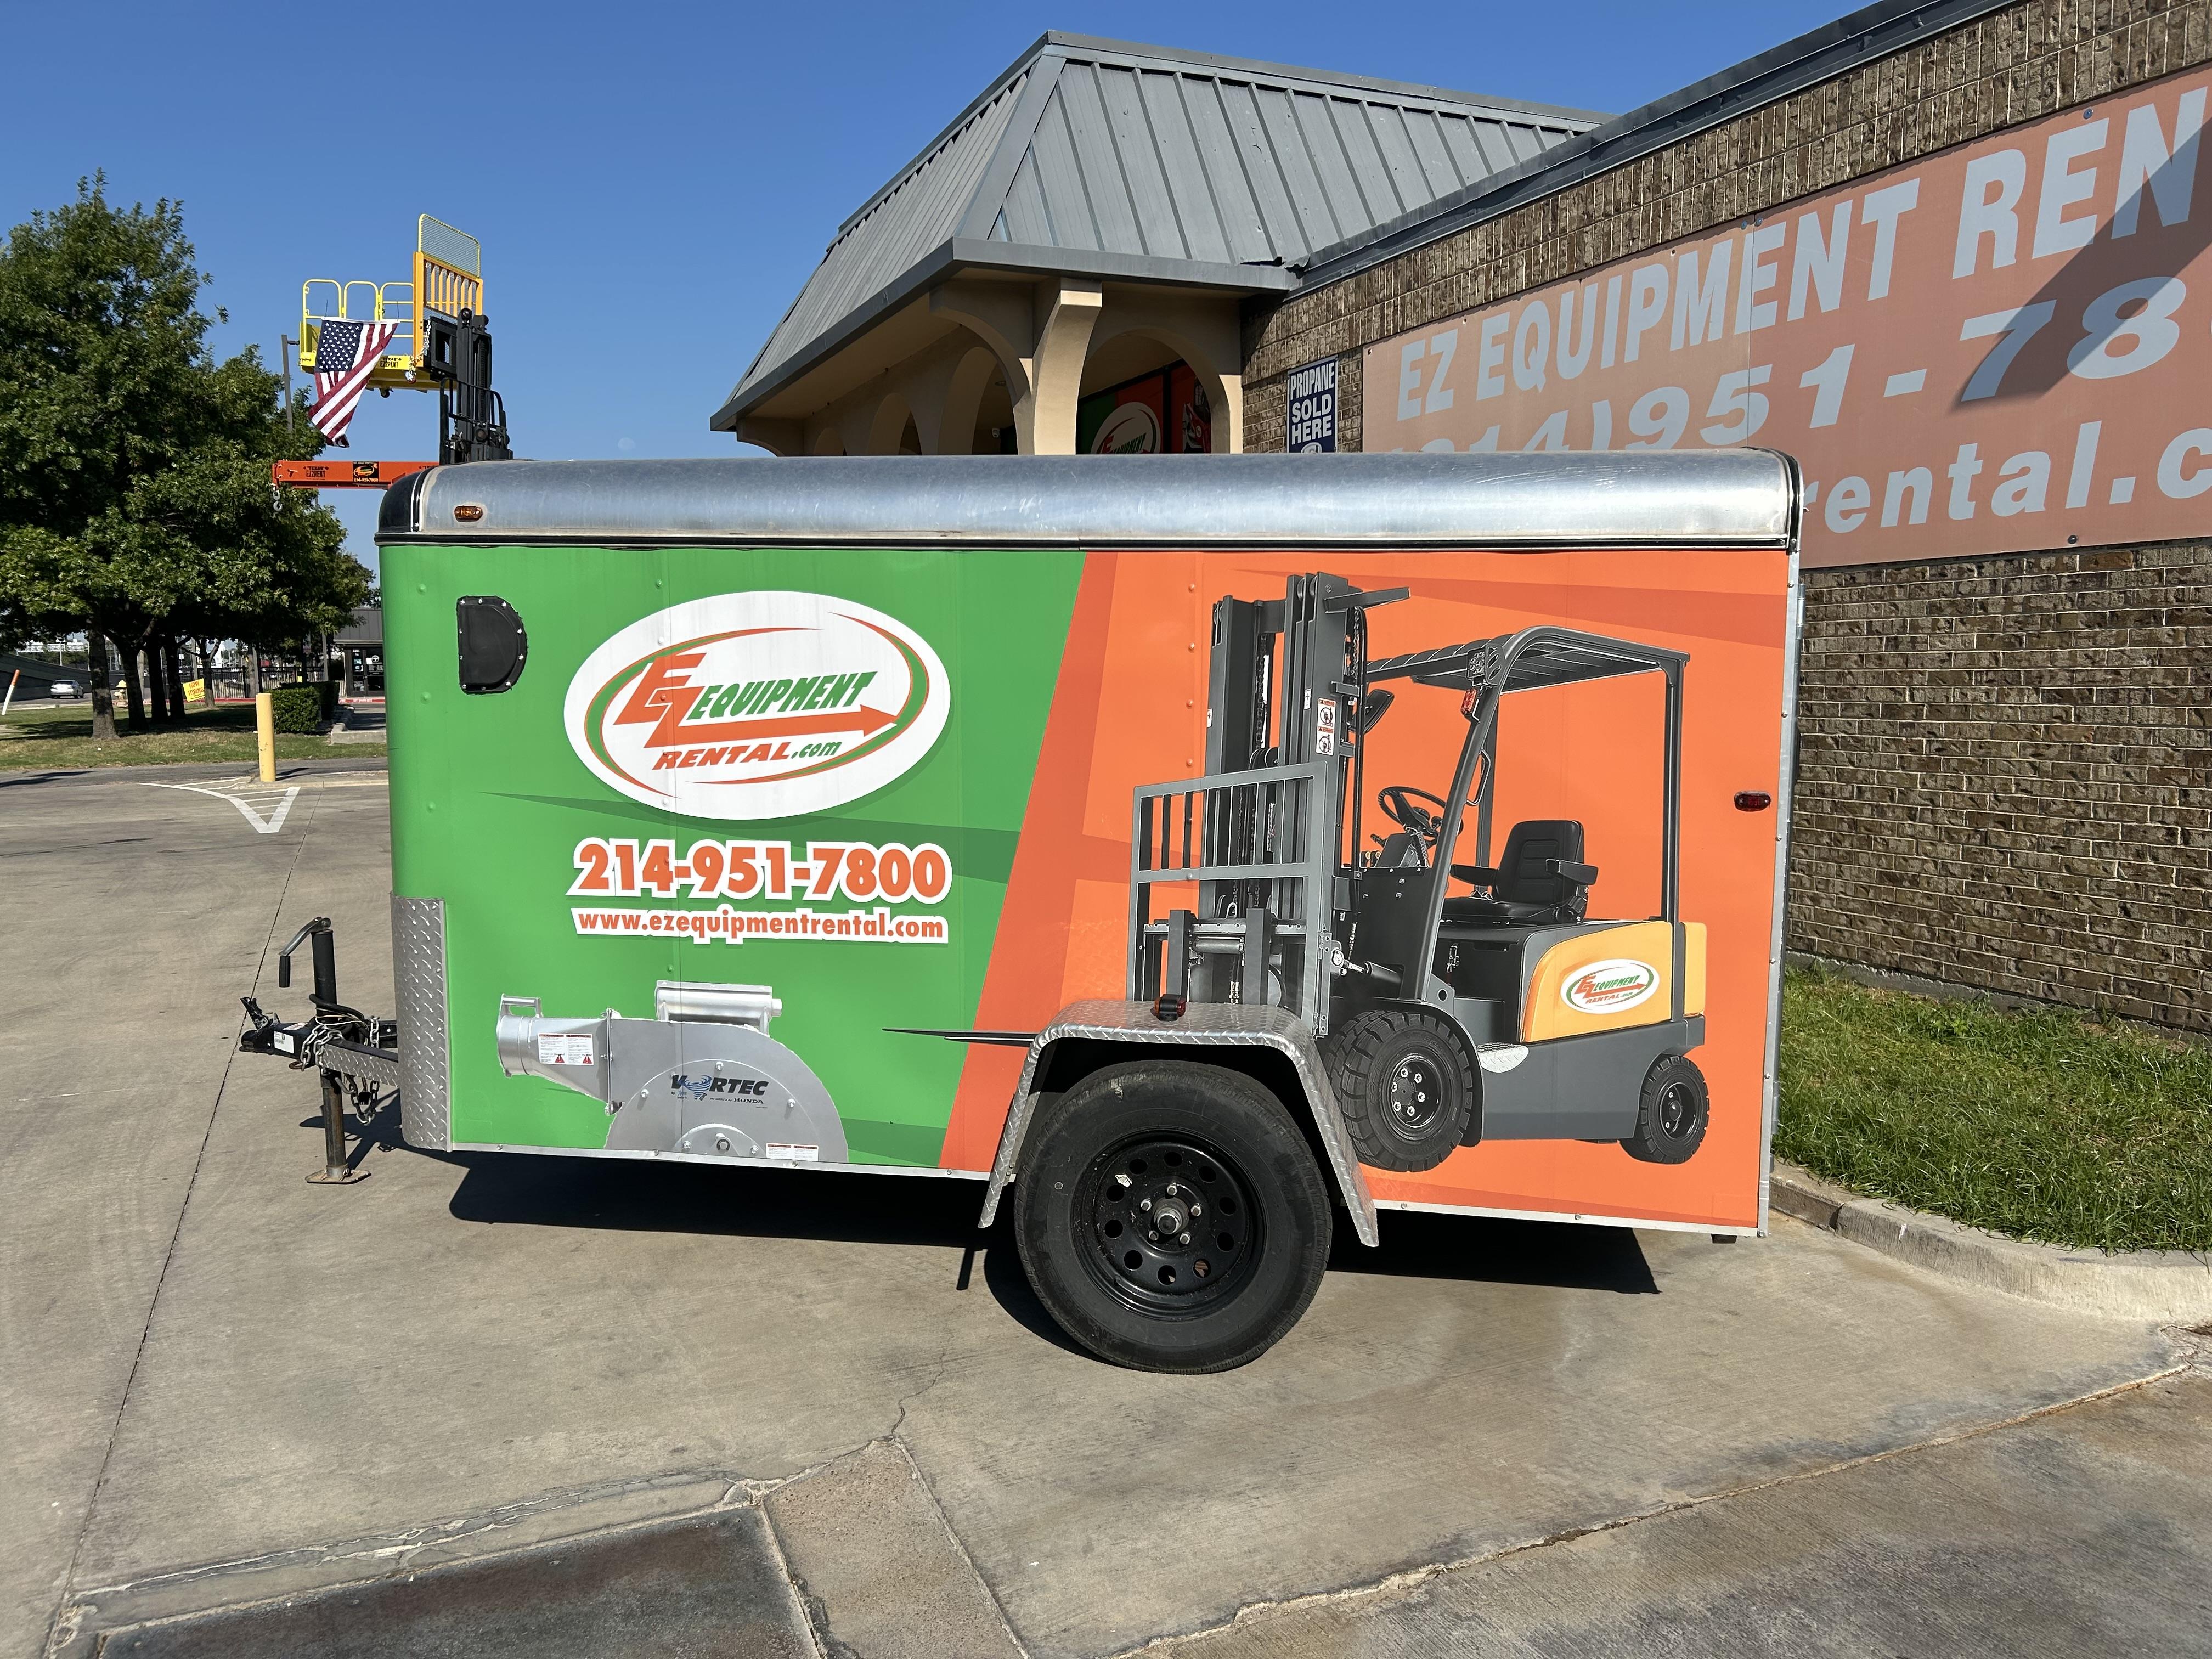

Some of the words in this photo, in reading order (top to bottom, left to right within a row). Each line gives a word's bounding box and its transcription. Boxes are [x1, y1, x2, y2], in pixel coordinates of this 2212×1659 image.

[1397, 329, 1458, 421] EZ
[1476, 178, 1920, 401] EQUIPMENT
[1953, 86, 2208, 280] REN
[1290, 362, 1334, 400] PROPANE
[1292, 394, 1332, 423] SOLD
[1291, 415, 1332, 445] HERE
[188, 687, 204, 696] HIRING
[613, 652, 707, 748] EZ
[686, 671, 878, 720] EQUIPMENT
[578, 843, 946, 898] 214-951-7800
[578, 909, 944, 939] www.ezequipmentrental.com
[1574, 975, 1596, 999] EZ
[1593, 974, 1641, 991] EQUIPMENT
